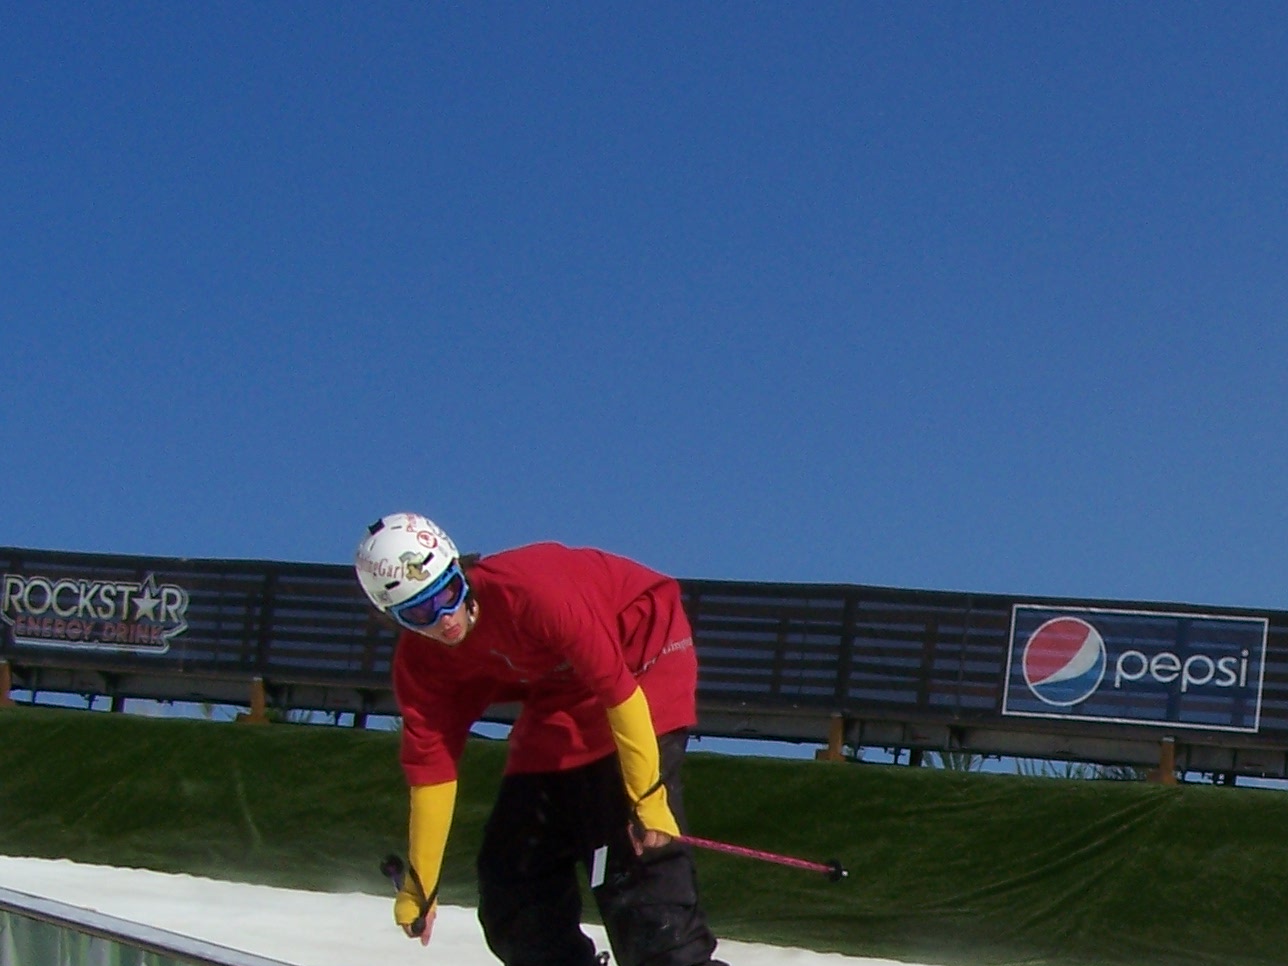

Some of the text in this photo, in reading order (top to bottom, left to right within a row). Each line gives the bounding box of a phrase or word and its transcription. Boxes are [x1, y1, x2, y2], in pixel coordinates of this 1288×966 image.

[15, 615, 164, 644] ENERGY DRINK
[1115, 650, 1249, 692] pepsi
